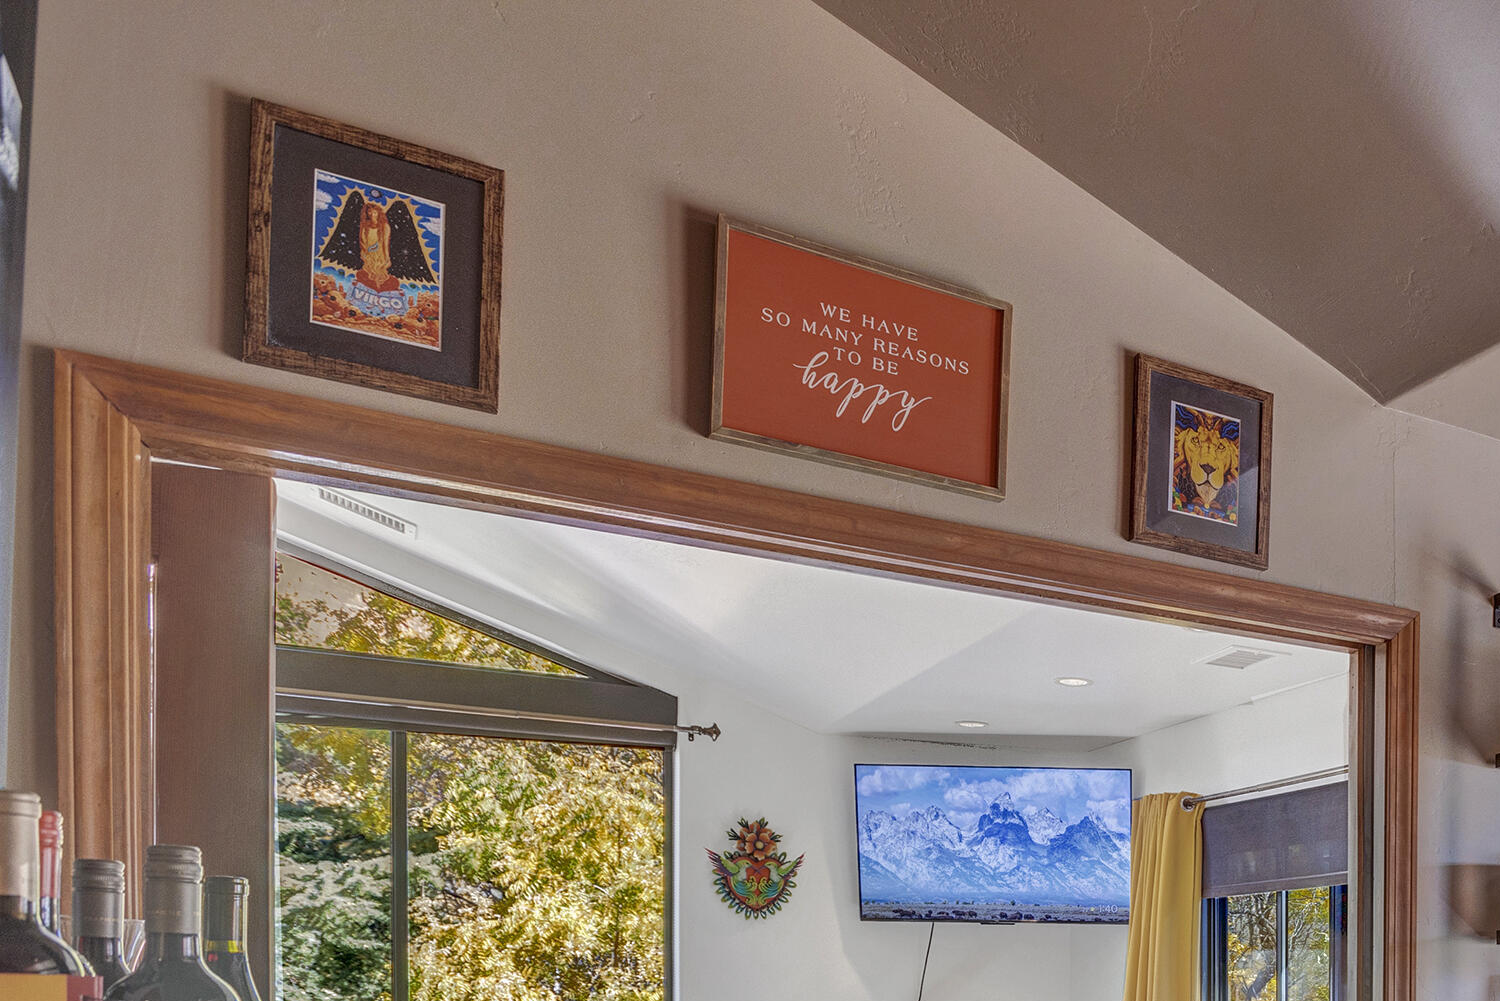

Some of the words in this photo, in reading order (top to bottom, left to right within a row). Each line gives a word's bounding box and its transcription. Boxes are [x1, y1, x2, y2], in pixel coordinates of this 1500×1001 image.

[353, 286, 403, 310] VIRGO
[819, 302, 852, 323] WE
[861, 313, 919, 342] HAVE
[760, 307, 791, 327] SO
[801, 318, 863, 346] MANY
[873, 337, 970, 375] REASONS
[832, 346, 862, 366] TO
[871, 357, 899, 376] BE
[792, 351, 933, 432] happy
[1099, 904, 1118, 913] 1:40
